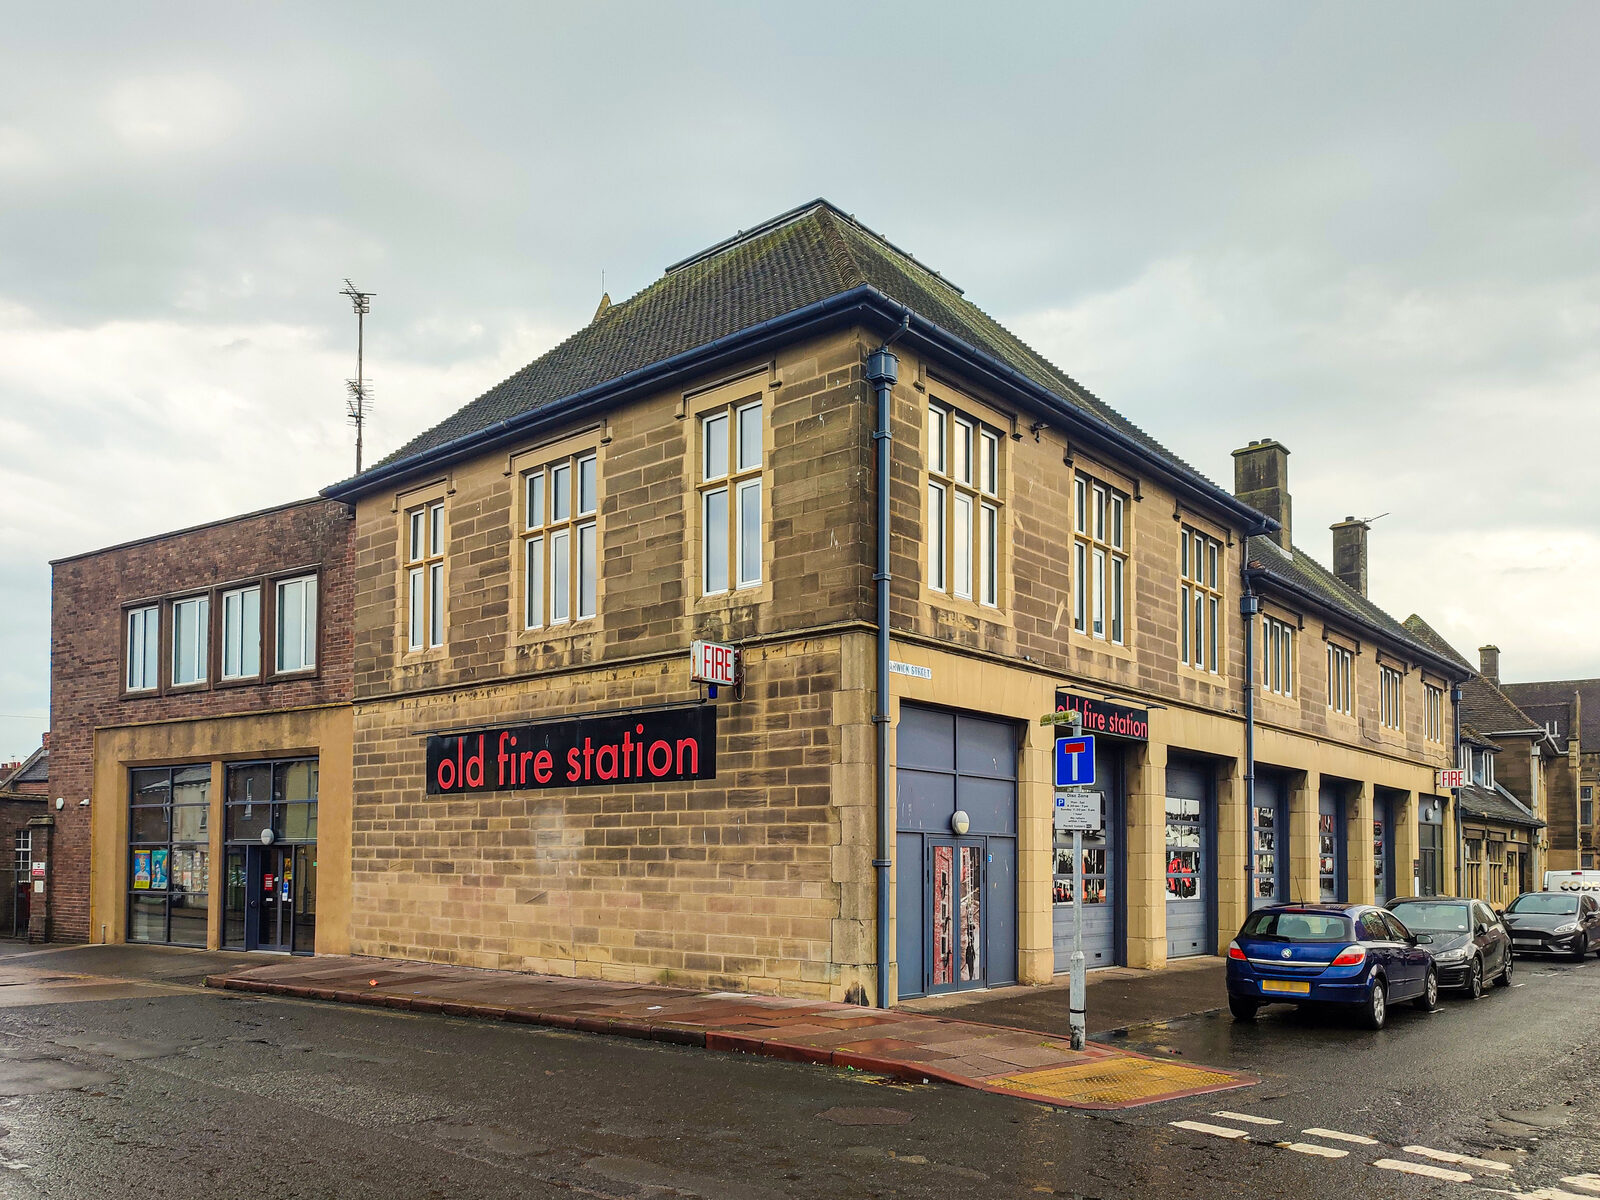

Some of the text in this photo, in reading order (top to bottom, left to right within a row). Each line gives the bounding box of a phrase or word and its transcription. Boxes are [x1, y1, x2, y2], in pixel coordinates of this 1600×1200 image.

[704, 645, 732, 681] FIRE
[911, 665, 930, 678] STREET
[1083, 700, 1105, 730] fire
[1109, 711, 1148, 738] station
[437, 723, 698, 789] old fire station
[1442, 770, 1463, 786] FIRE
